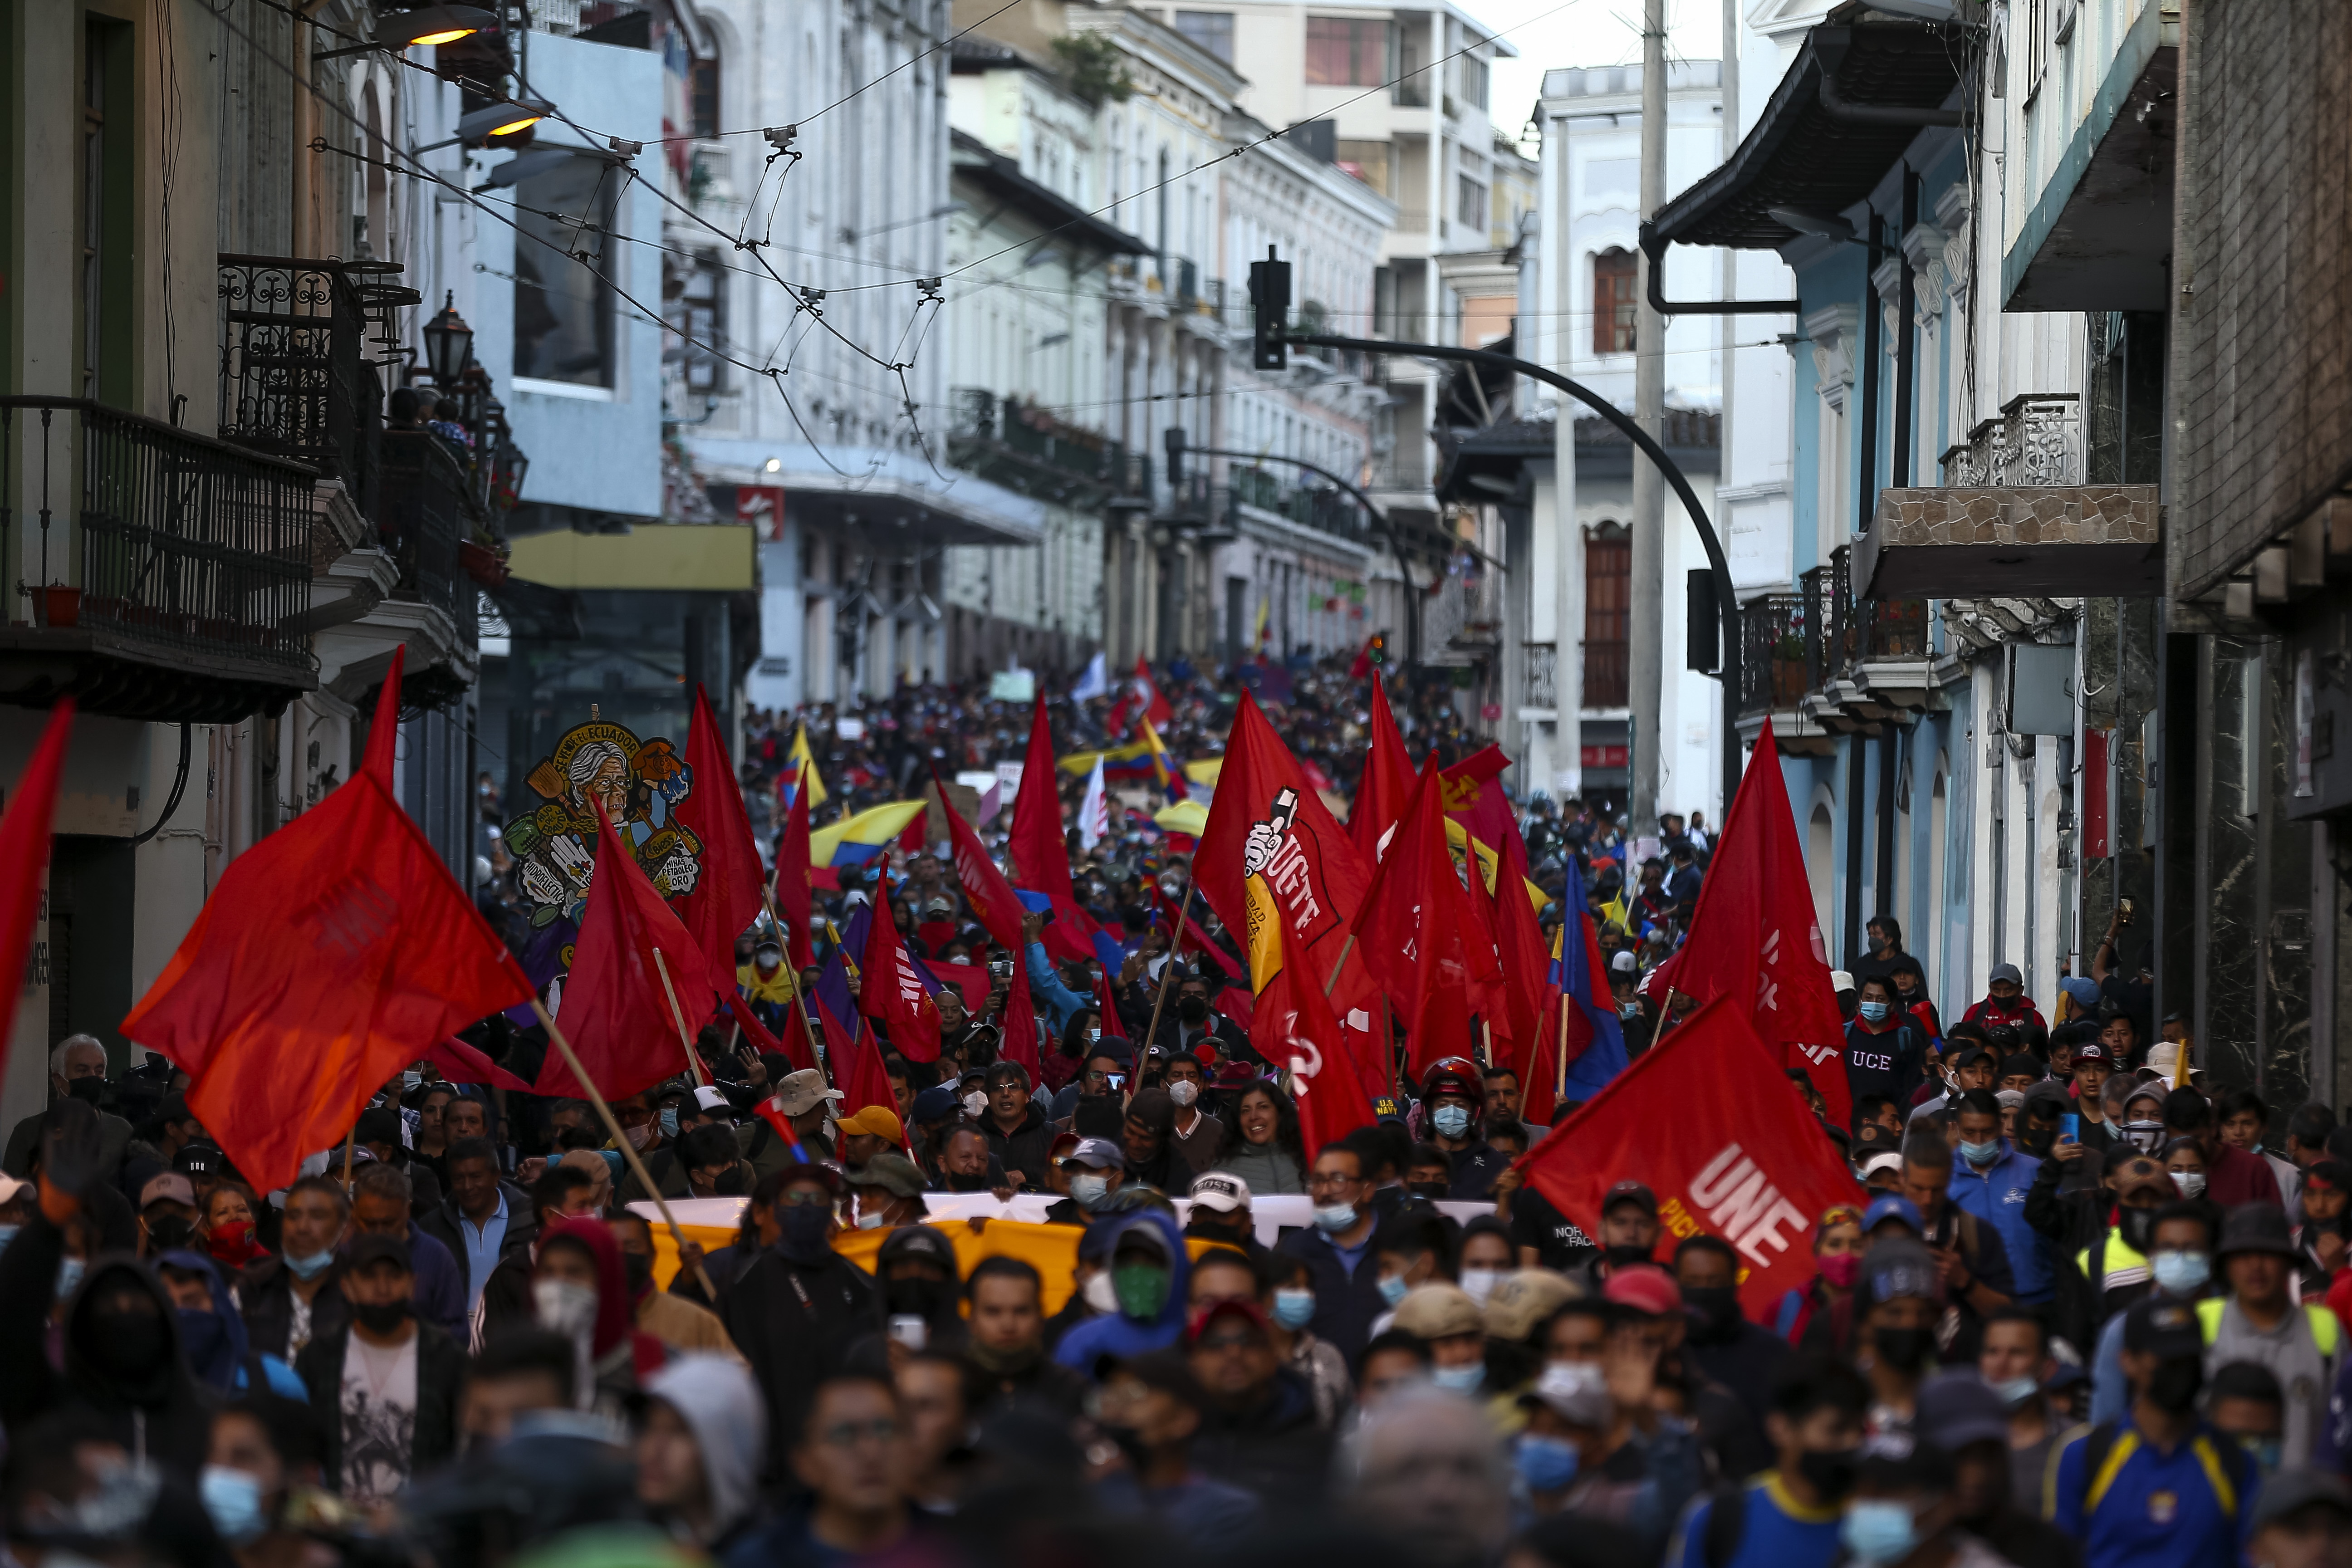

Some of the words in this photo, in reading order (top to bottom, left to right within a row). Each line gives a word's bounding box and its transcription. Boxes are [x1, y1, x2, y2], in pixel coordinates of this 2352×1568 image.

[577, 731, 588, 743] EL
[588, 726, 637, 754] ECUADOR
[538, 806, 553, 823] HIJO
[545, 815, 556, 826] DEL
[541, 810, 567, 834] FRAUDE
[666, 859, 685, 868] MINAS
[672, 875, 688, 886] ORO
[1853, 1050, 1892, 1071] UCE
[1377, 1106, 1397, 1116] NAVY
[1195, 1181, 1230, 1192] BOSS
[1689, 1142, 1811, 1269] UNE
